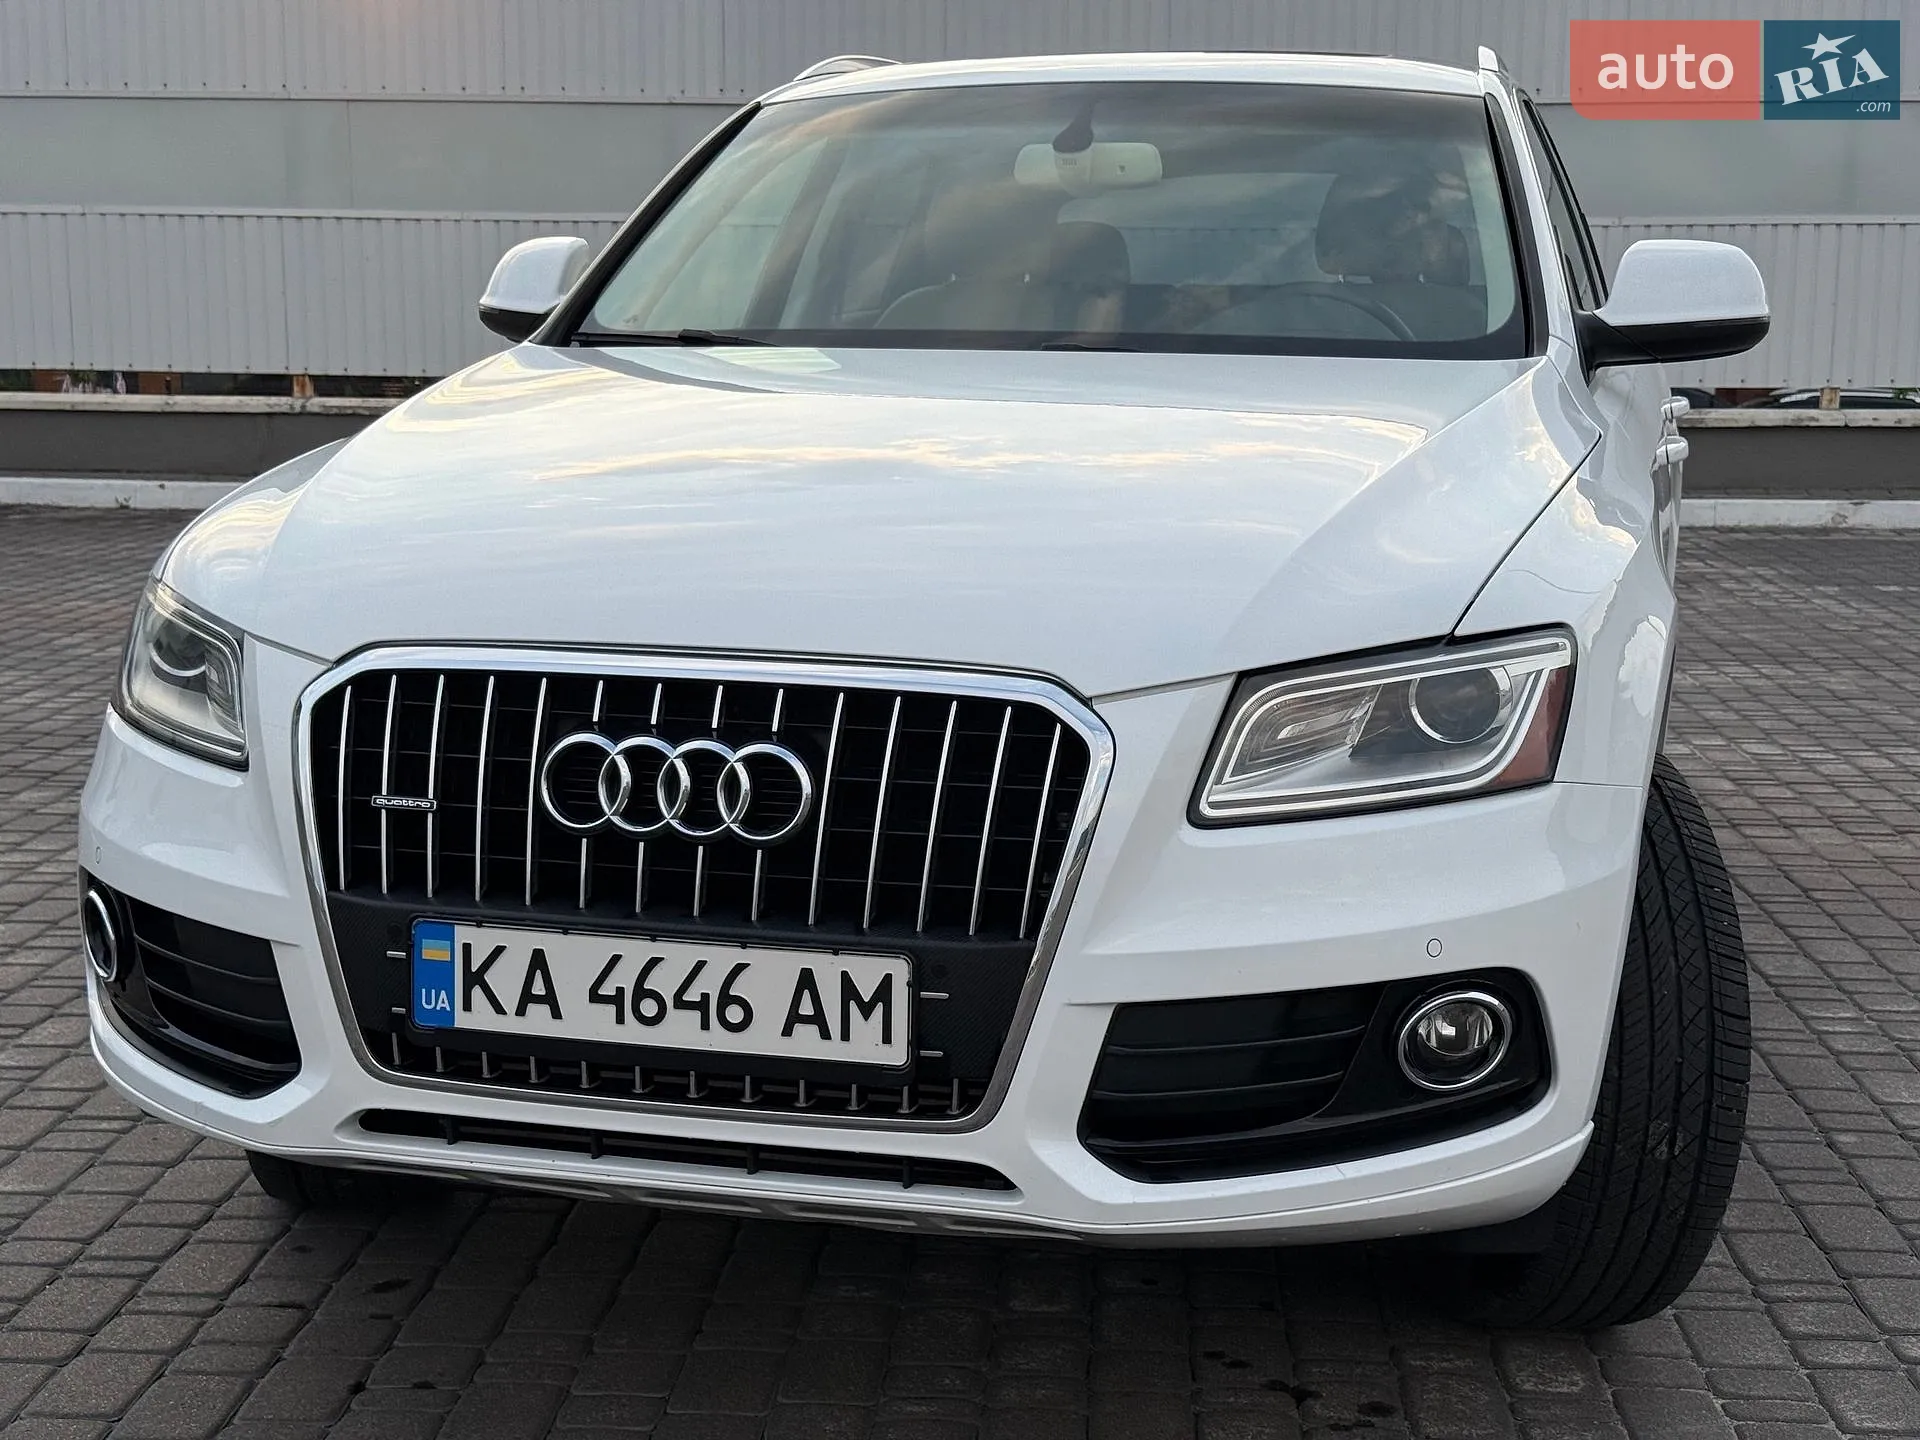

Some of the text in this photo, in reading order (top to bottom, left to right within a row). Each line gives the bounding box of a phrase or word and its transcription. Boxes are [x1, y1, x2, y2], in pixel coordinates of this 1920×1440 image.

[376, 798, 431, 808] quattro
[421, 988, 451, 1011] UA
[462, 942, 893, 1045] KA 4646 AM
